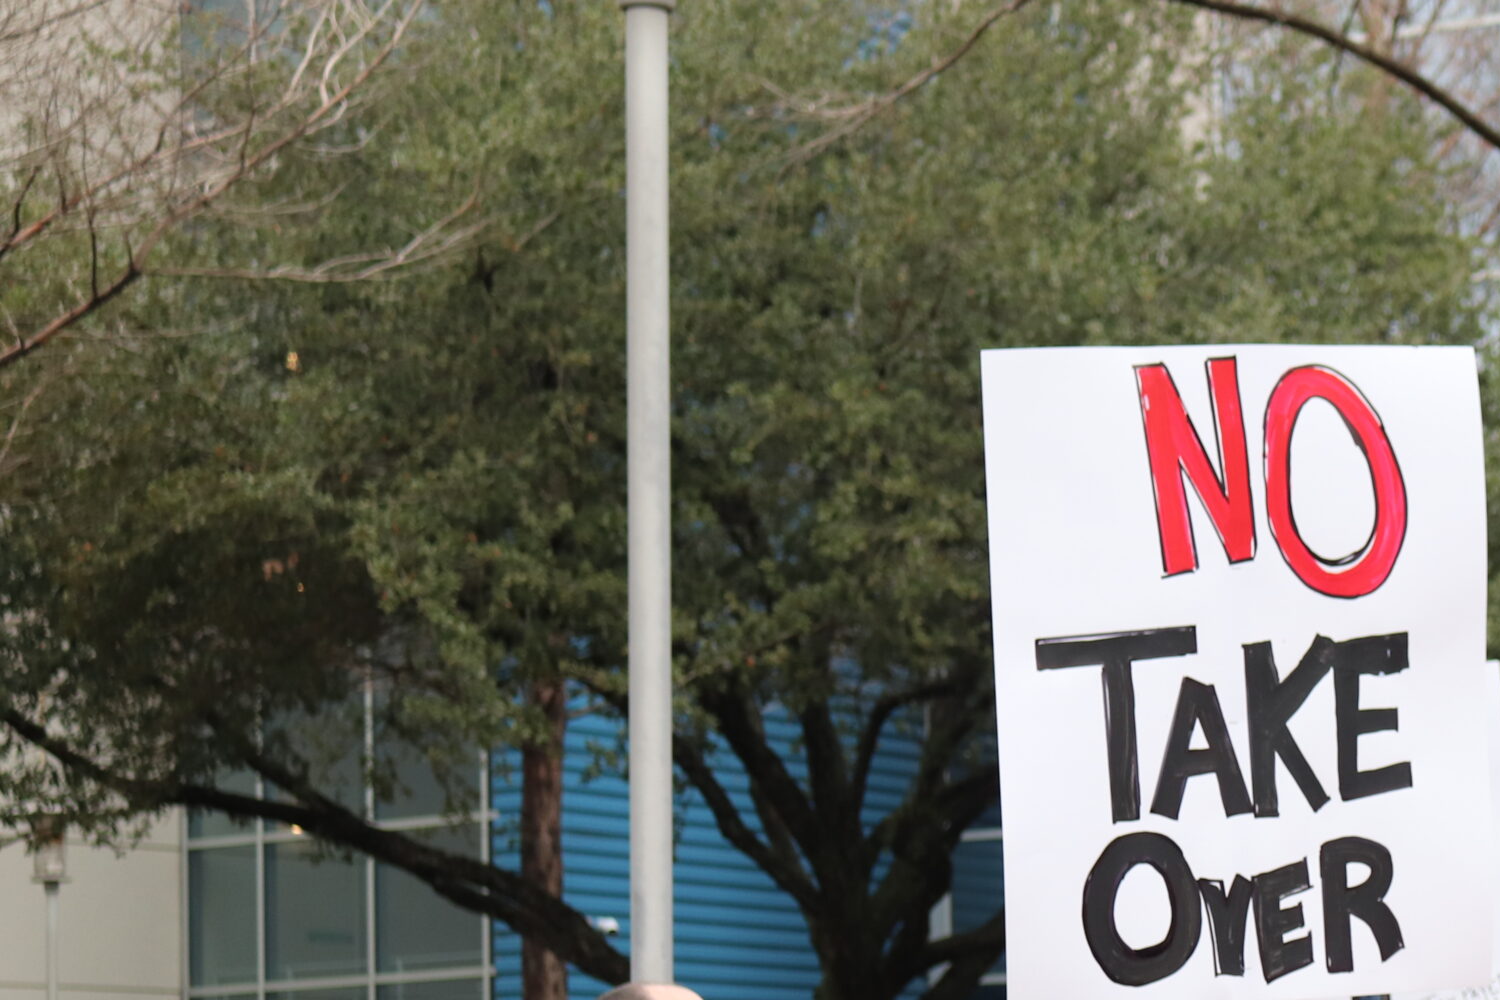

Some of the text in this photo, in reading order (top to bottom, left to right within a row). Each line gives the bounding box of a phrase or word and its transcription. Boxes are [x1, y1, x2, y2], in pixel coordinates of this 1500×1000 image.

[1134, 355, 1408, 599] NO
[1035, 625, 1413, 824] TAKE
[1082, 831, 1405, 987] OVER
